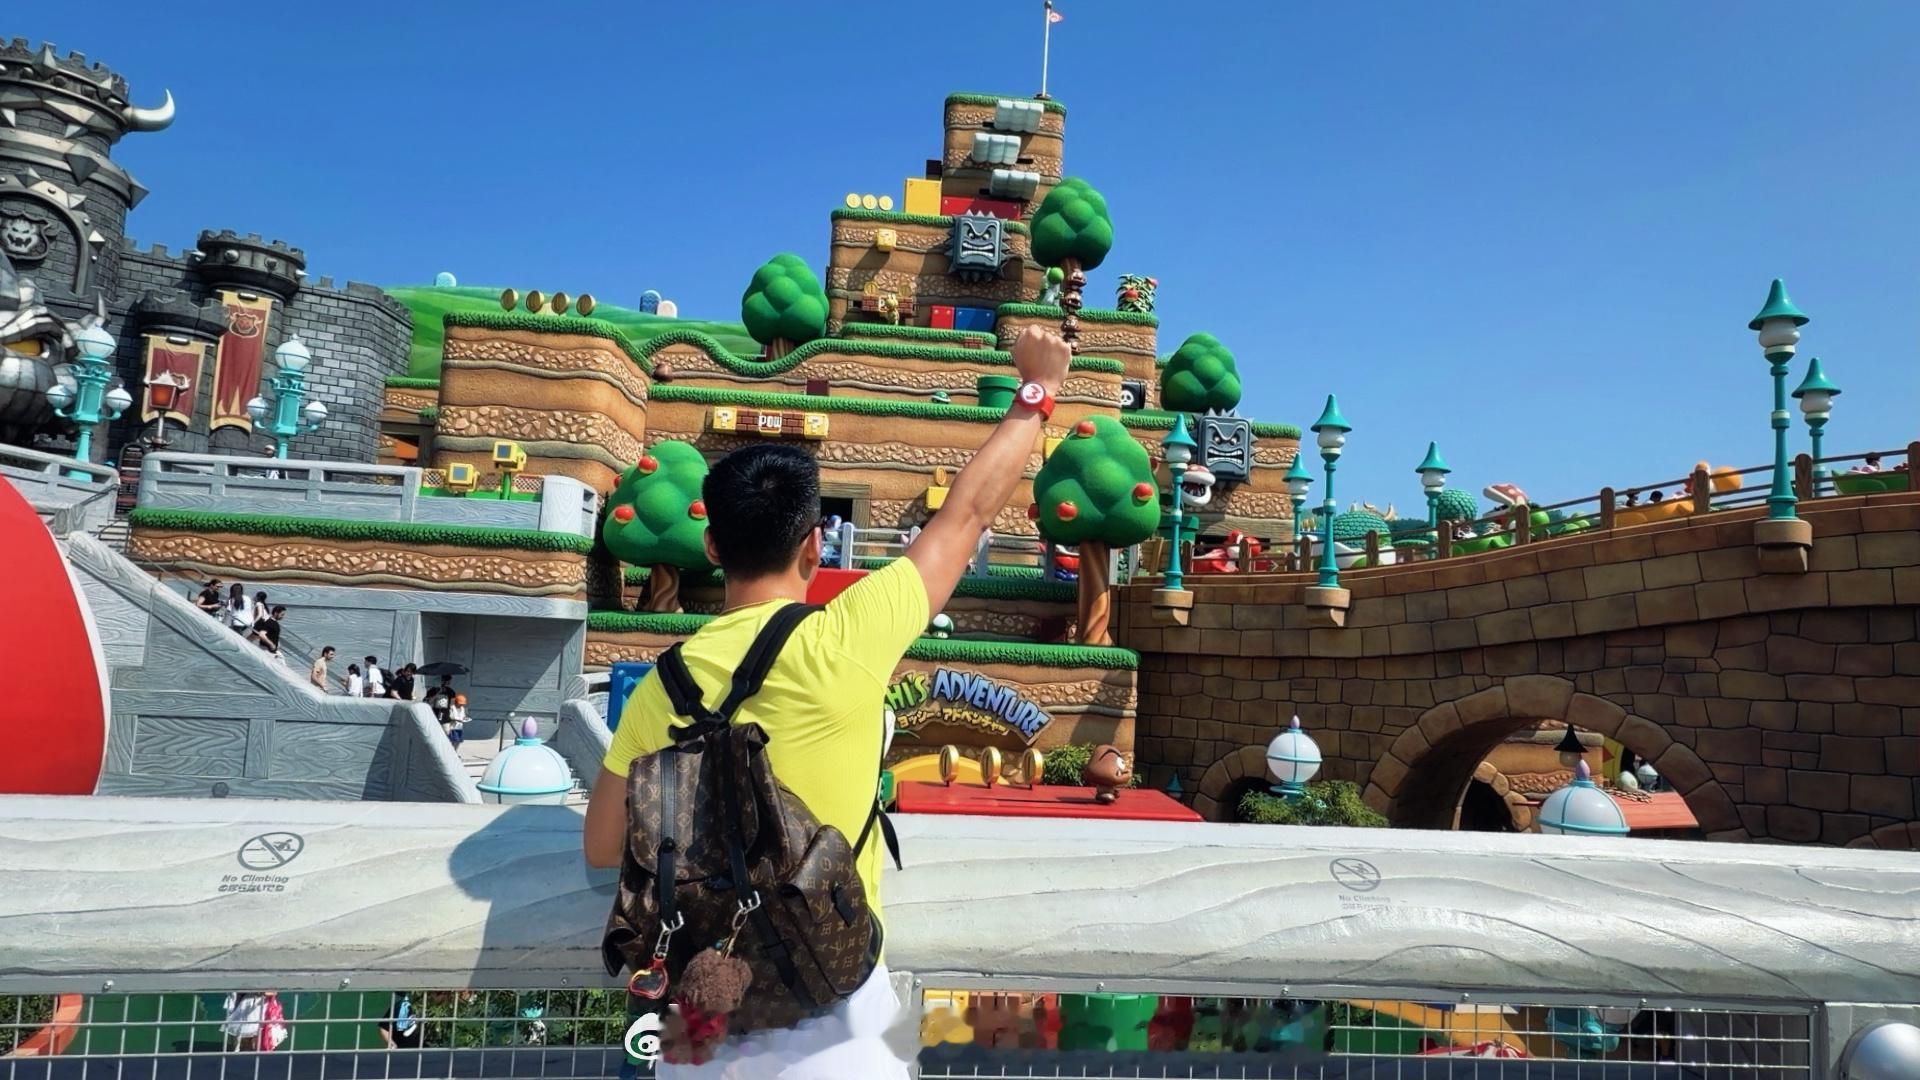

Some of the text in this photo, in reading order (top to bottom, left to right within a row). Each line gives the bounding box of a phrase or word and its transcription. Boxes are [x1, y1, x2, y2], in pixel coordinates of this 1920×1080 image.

[759, 415, 782, 428] POW
[886, 668, 1050, 738] HI'S ADVENTURE
[222, 874, 289, 884] No Climbing
